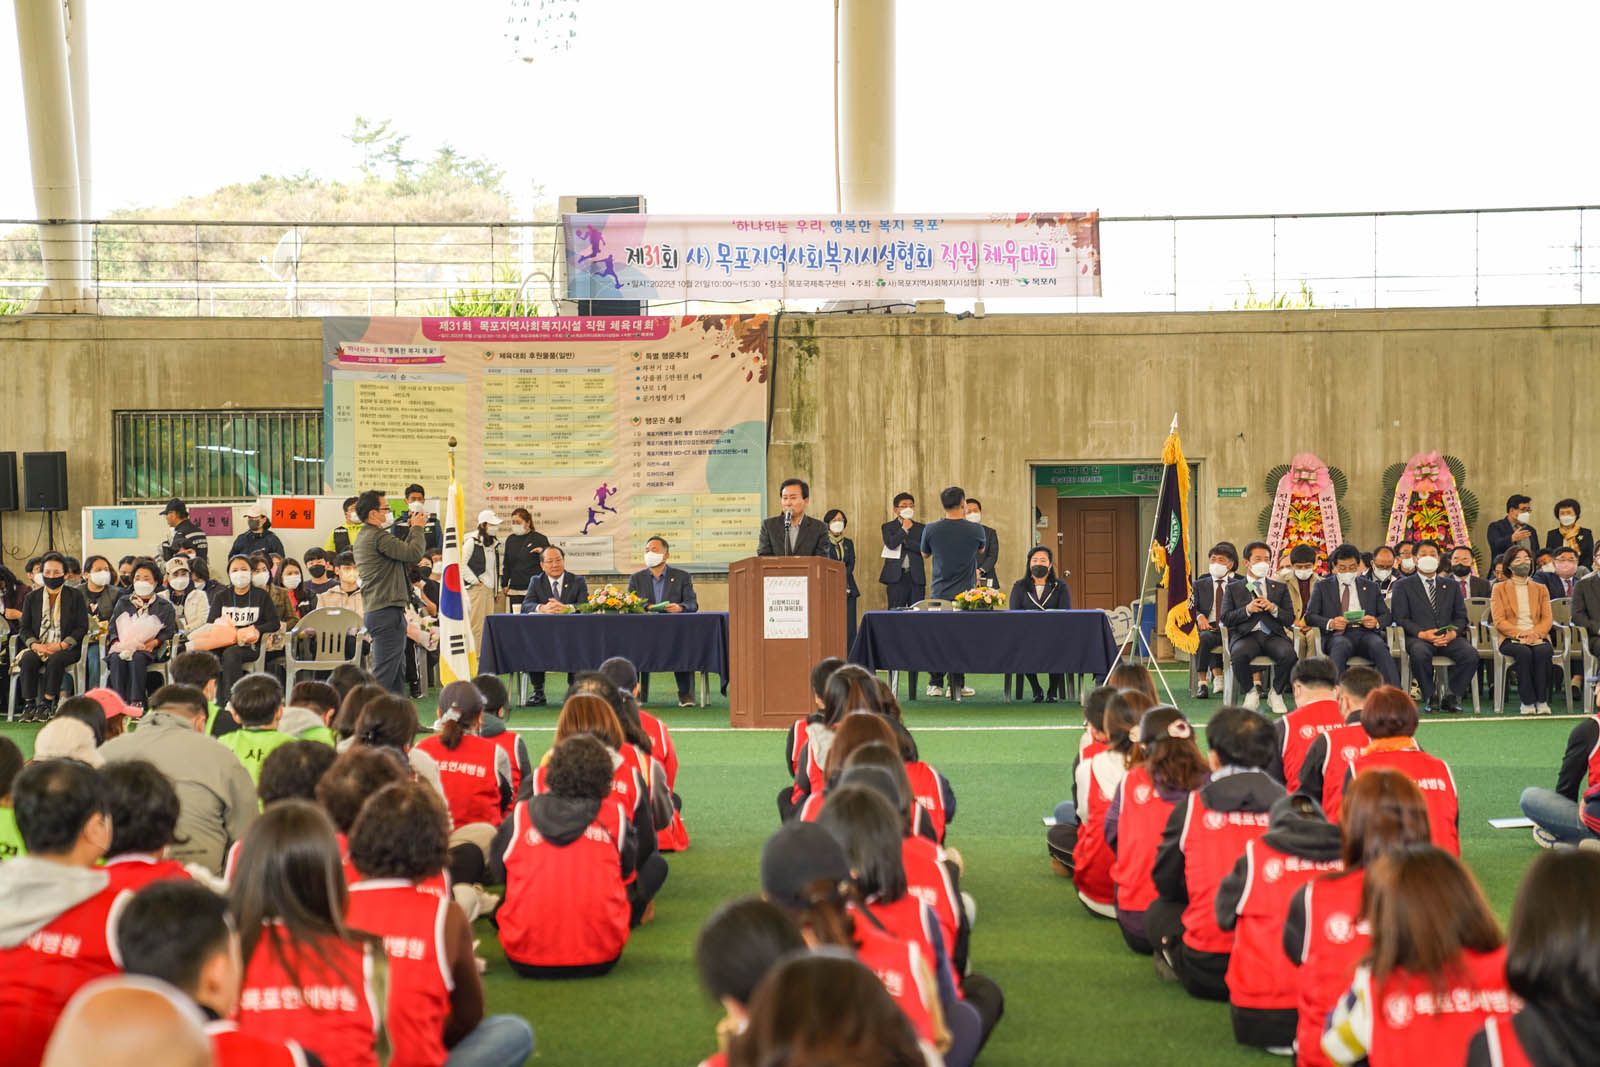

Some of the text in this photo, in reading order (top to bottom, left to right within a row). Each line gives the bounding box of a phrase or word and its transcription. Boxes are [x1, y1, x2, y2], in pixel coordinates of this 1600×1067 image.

[796, 219, 825, 234] 우리,
[830, 219, 871, 234] 행복한
[879, 219, 905, 233] 복지
[625, 244, 678, 269] 제31회
[940, 239, 977, 272] 직원
[983, 239, 1055, 272] 체육대회
[439, 320, 472, 332] 제31회
[586, 320, 606, 332] 직원
[610, 319, 654, 332] 체육대회
